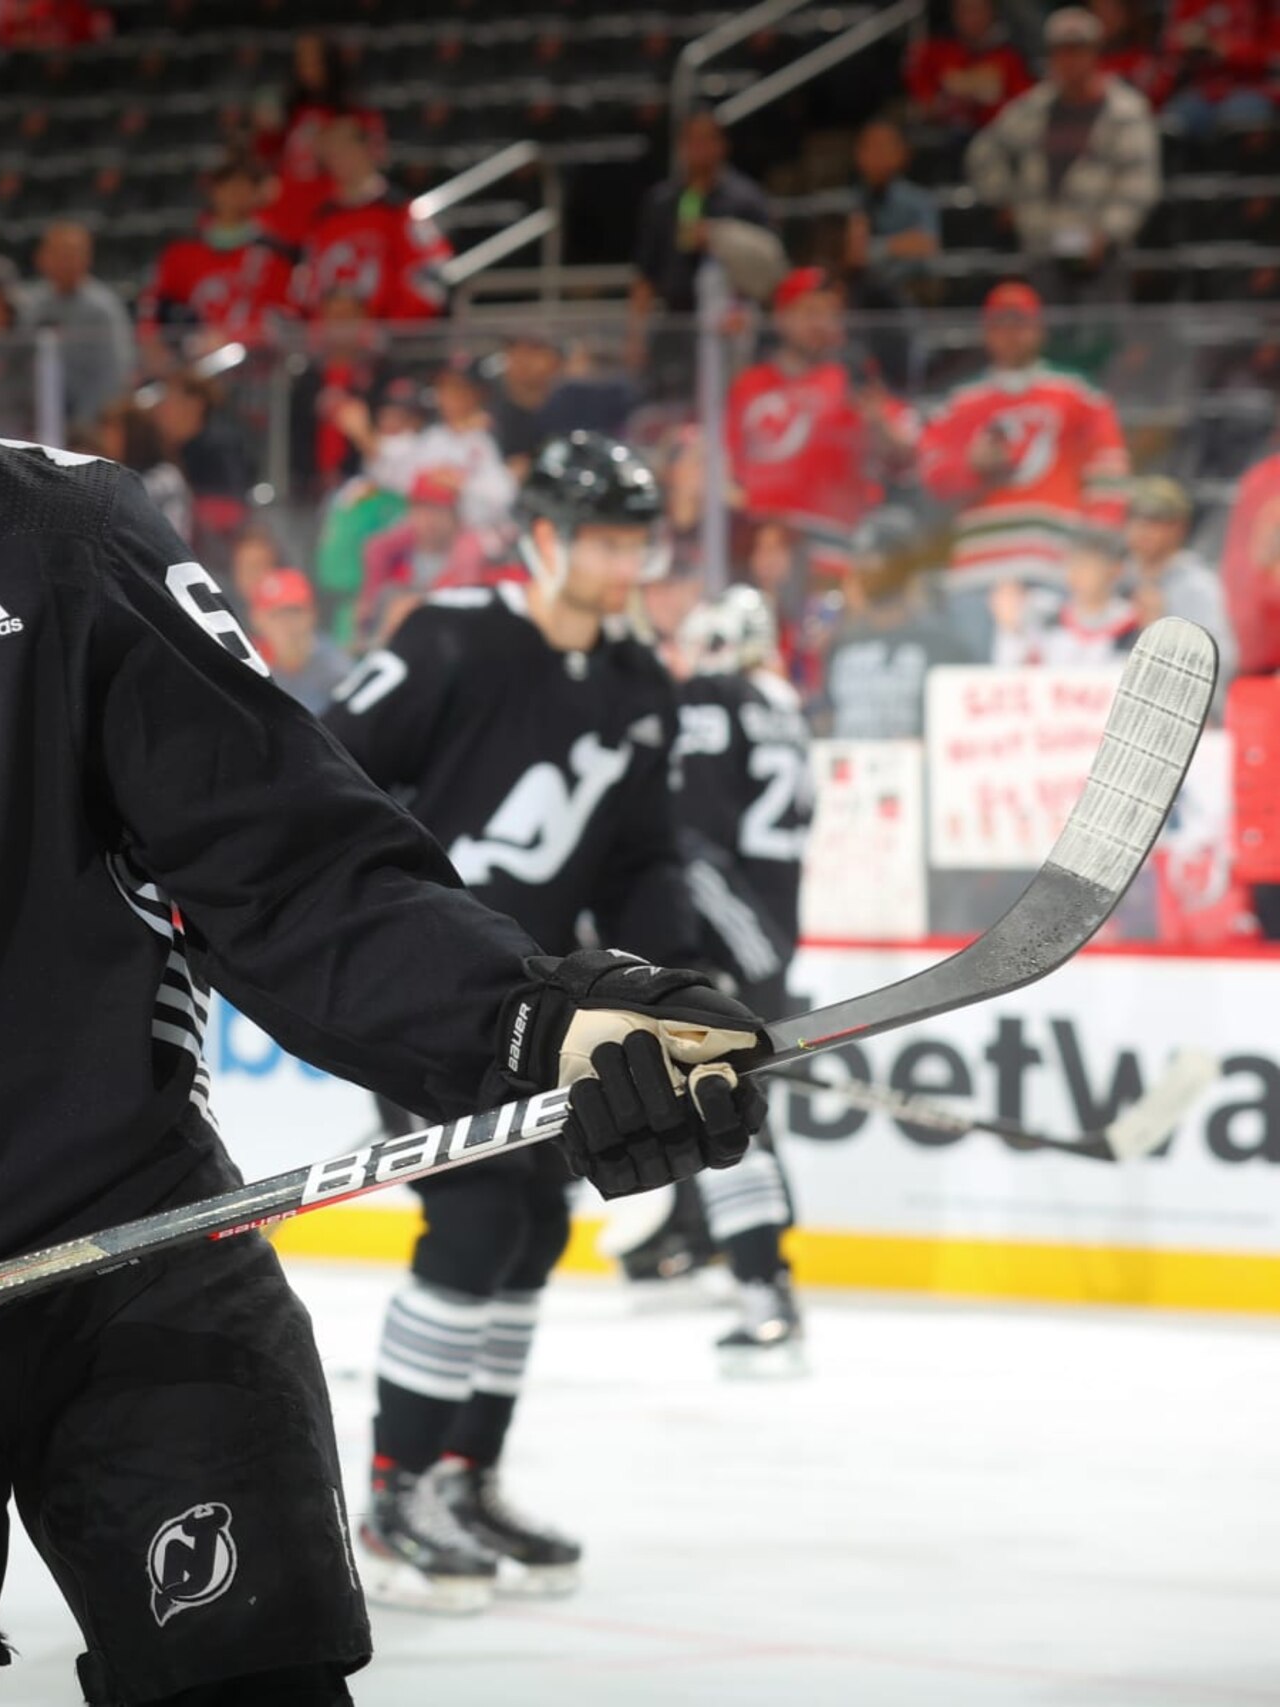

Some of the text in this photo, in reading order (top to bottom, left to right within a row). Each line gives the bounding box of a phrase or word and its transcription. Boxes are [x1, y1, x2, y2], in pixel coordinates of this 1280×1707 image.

[508, 1002, 532, 1072] BAUER
[300, 1086, 570, 1206] BAUE
[218, 1210, 299, 1240] BAUER
